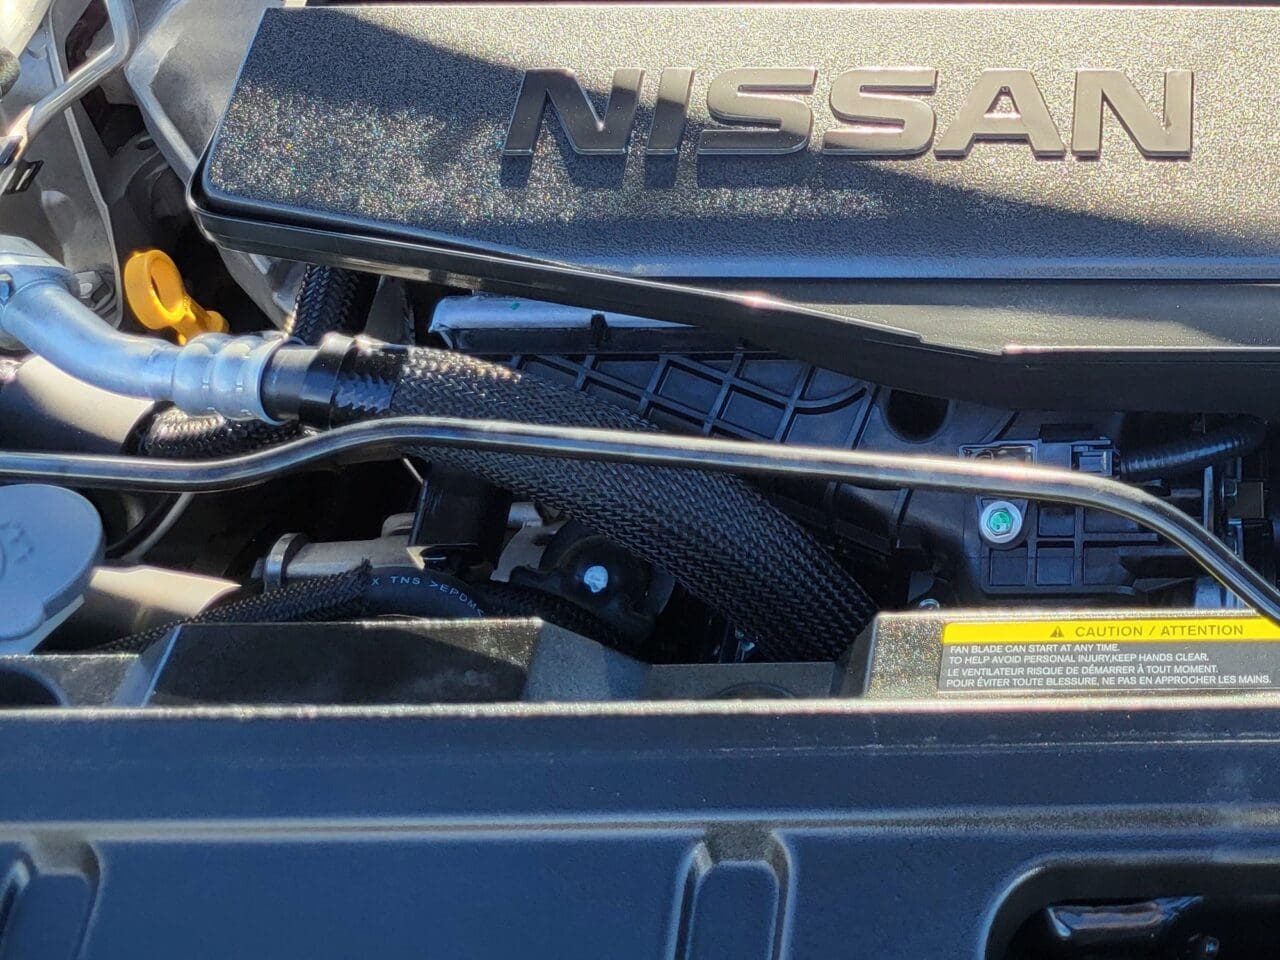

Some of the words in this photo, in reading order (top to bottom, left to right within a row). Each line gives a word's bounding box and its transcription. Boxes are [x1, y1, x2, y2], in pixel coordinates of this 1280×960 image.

[503, 66, 1195, 159] NISSAN
[390, 575, 421, 586] TNS
[1075, 626, 1143, 637] CAUTION
[1160, 625, 1244, 636] ATTENTION
[950, 645, 969, 654] FAN
[971, 645, 1003, 654] BLADE
[1005, 644, 1026, 653] CAN
[1028, 644, 1058, 653] START
[1060, 644, 1072, 652] AT
[1073, 644, 1094, 652] ANY
[949, 656, 962, 665] TO
[965, 655, 990, 664] HELP
[991, 655, 1022, 664] AVOID
[1024, 654, 1076, 664] PERSONAL
[1138, 653, 1173, 662] HANDS
[1175, 653, 1209, 661] CLEAR.
[947, 668, 959, 677] LE
[961, 667, 1024, 677] VENTILATEUR
[1026, 667, 1064, 676] RISQUE
[1066, 666, 1079, 675] DE
[1081, 664, 1135, 675] DÉMARRER
[1137, 663, 1144, 673] À
[1146, 665, 1172, 674] TOUT
[1173, 665, 1219, 673] MOMENT.
[946, 679, 975, 688] POUR
[977, 676, 1010, 687] ÉVITER
[1012, 677, 1043, 686] TOUTE
[1046, 677, 1100, 687] BLESSURE,
[1102, 676, 1115, 685] NE
[1117, 676, 1137, 685] PAS
[1139, 676, 1153, 685] EN
[1155, 675, 1216, 684] APPROCHER
[1218, 675, 1236, 684] LES
[1238, 674, 1272, 684] MAINS.
